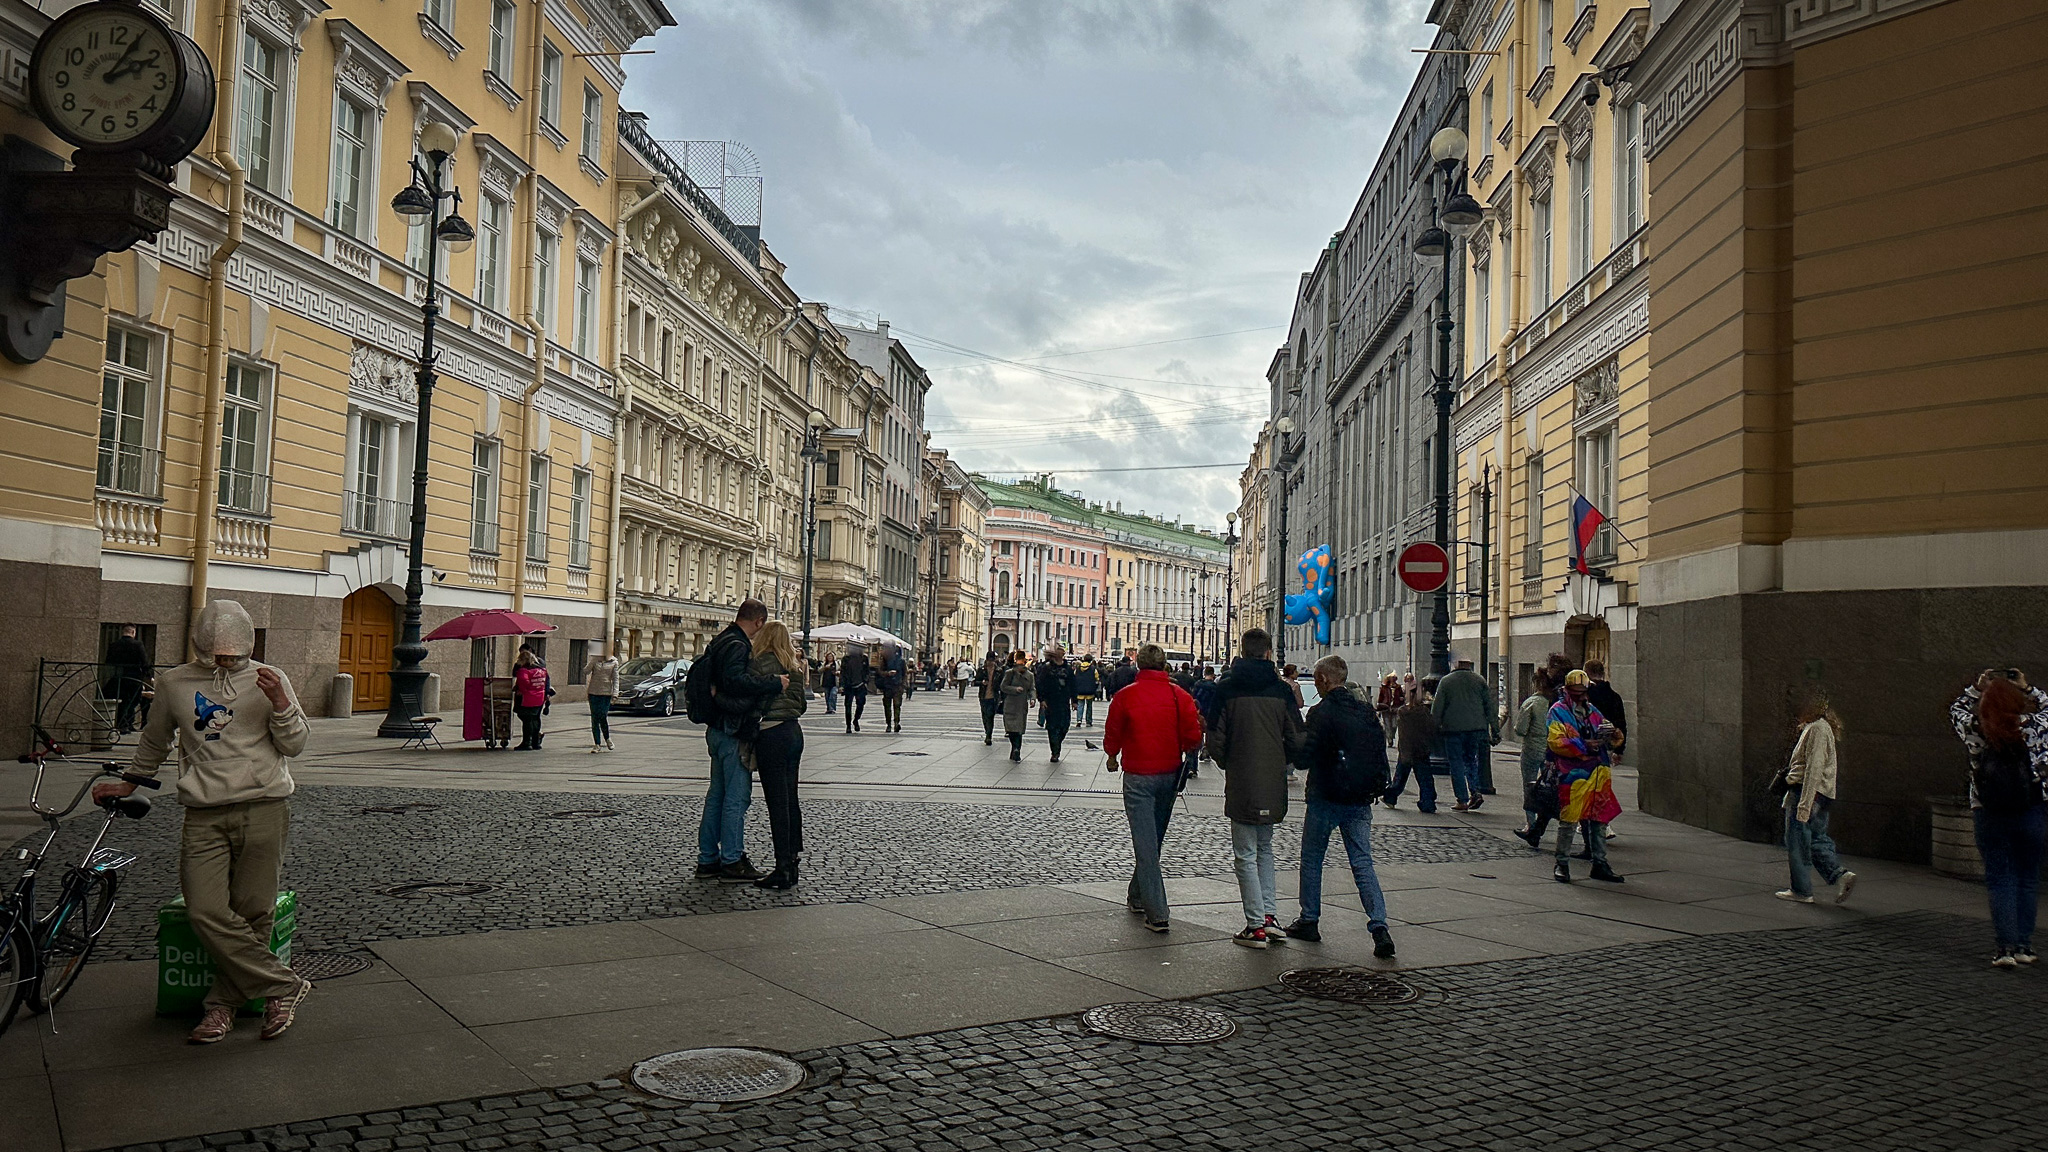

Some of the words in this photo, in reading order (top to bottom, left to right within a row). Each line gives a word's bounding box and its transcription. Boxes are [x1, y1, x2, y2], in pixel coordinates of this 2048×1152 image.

[88, 31, 99, 50] 11
[109, 26, 129, 45] 12
[65, 47, 84, 67] 10
[147, 50, 161, 69] 2
[55, 70, 70, 89] 9
[153, 72, 167, 91] 3
[61, 92, 76, 112] 8
[140, 94, 158, 114] 4
[80, 108, 95, 127] 7
[101, 115, 116, 134] 6
[124, 110, 139, 129] 5
[165, 945, 215, 965] Deli
[165, 967, 216, 987] Club
